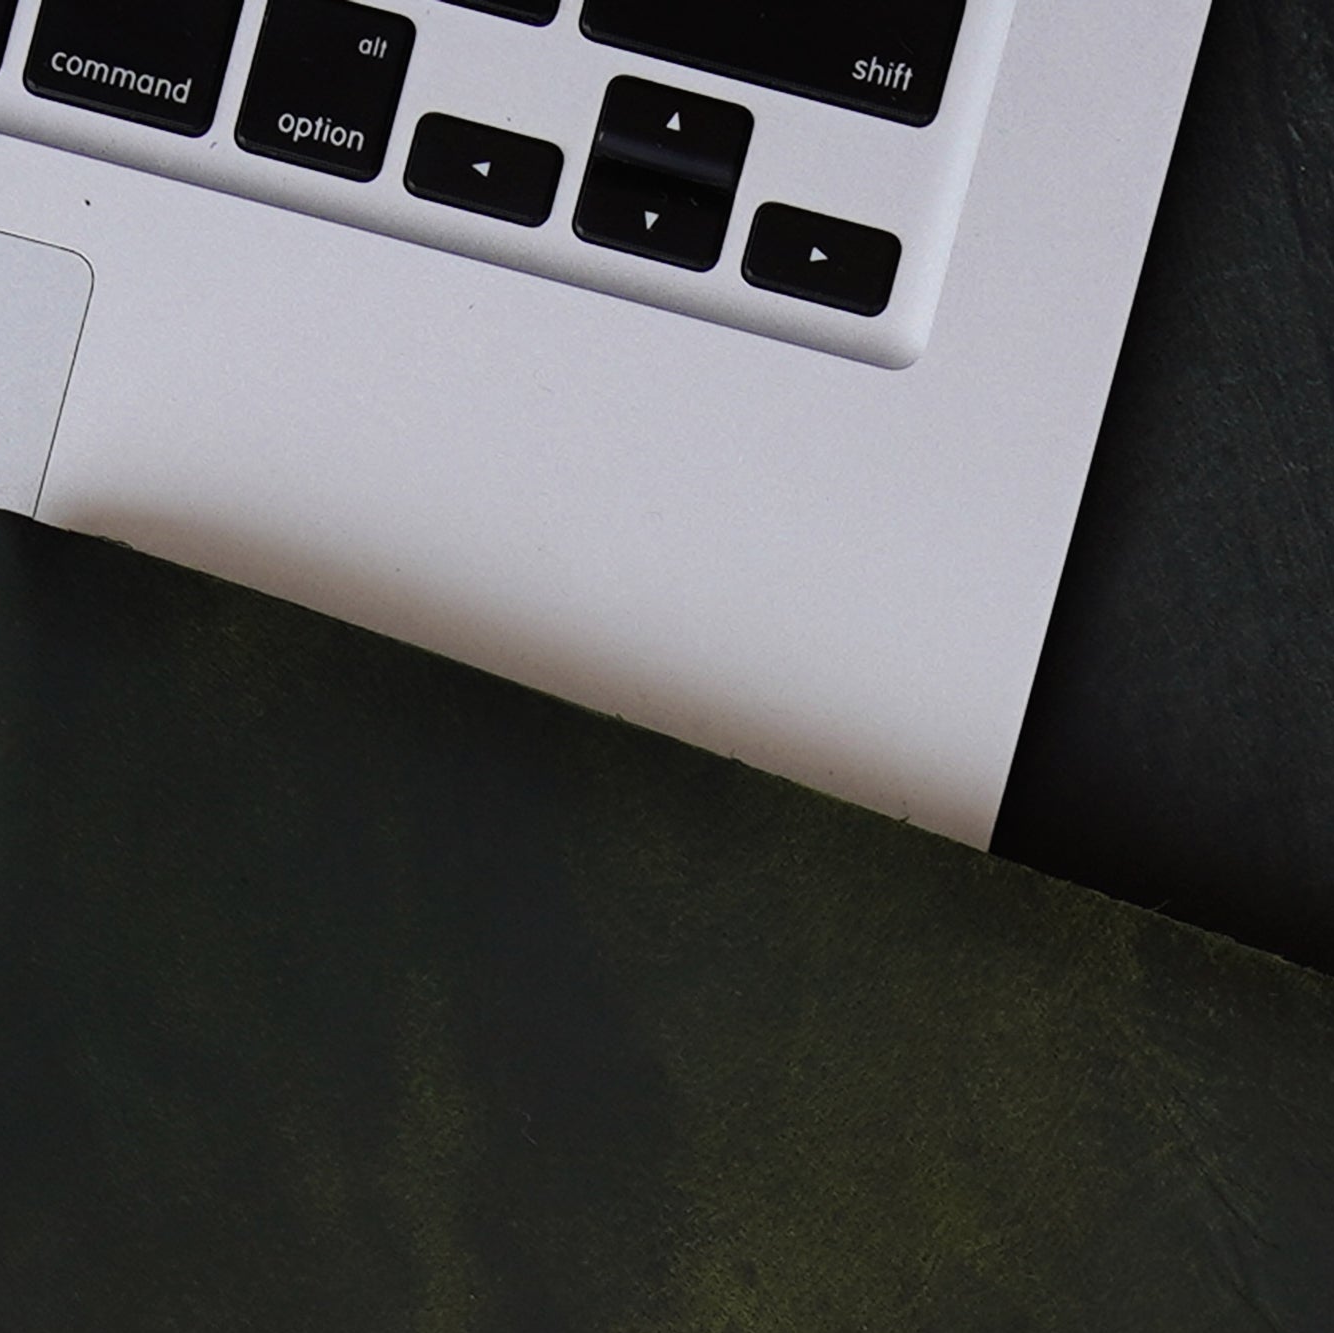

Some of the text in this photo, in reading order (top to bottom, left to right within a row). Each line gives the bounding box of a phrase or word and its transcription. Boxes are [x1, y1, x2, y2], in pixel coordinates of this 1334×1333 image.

[359, 37, 387, 58] alt
[50, 51, 192, 104] command
[853, 57, 912, 90] shift
[279, 114, 364, 150] option
